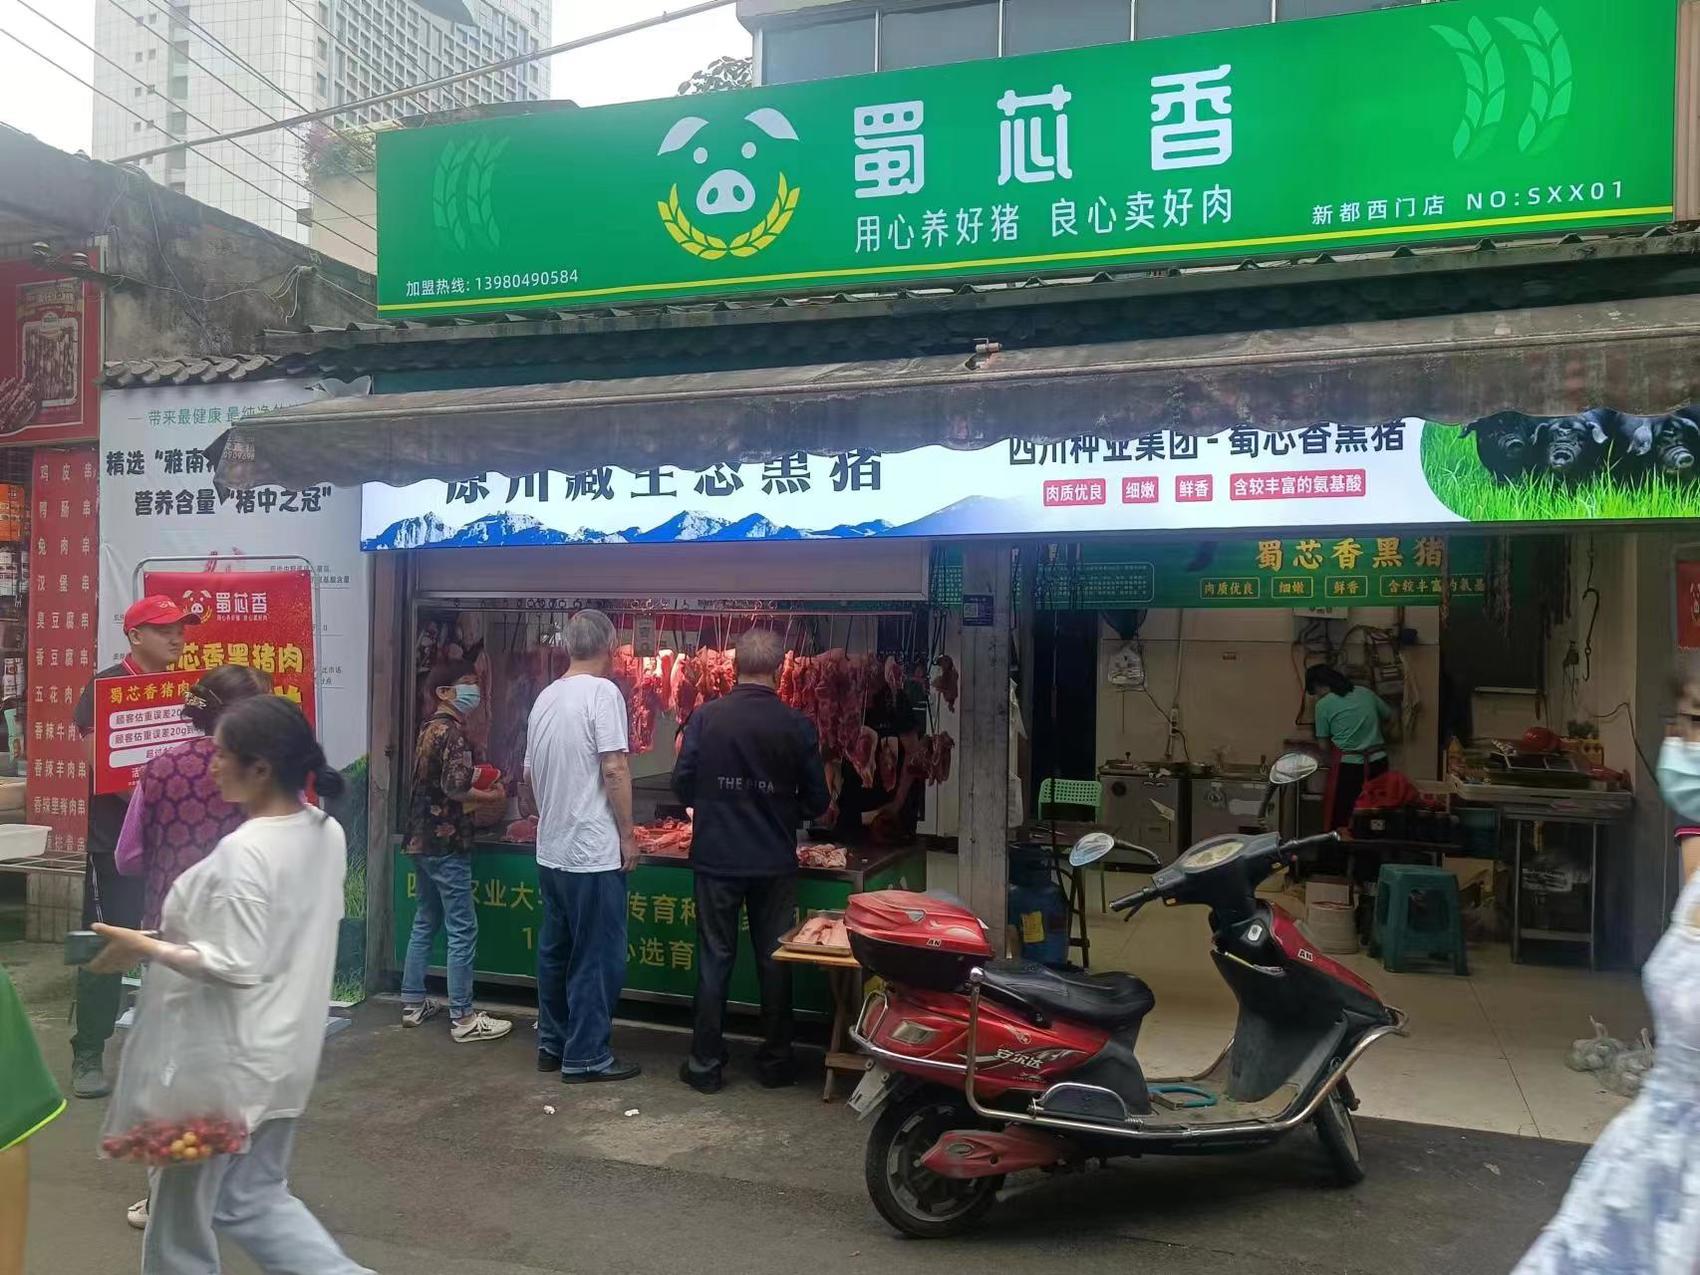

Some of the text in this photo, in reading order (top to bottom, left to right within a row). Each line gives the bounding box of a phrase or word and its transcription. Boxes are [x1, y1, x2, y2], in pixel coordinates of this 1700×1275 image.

[854, 64, 1232, 198] 蜀芯香
[1312, 180, 1622, 225] 新都西门店 NO:SXX01
[855, 183, 1232, 254] 用心养好猪 良心卖好肉
[1045, 473, 1362, 502] 肉质优良 细嫩 鲜香 含较丰富的氨基酸
[1256, 536, 1446, 571] 蜀芯香黑猪
[216, 592, 268, 613] 蜀芯香
[166, 643, 304, 673] 芯香黑猪肉
[110, 679, 199, 704] 蜀芯香猪肉
[34, 722, 85, 742] 香辣牛肉
[717, 776, 742, 790] THE
